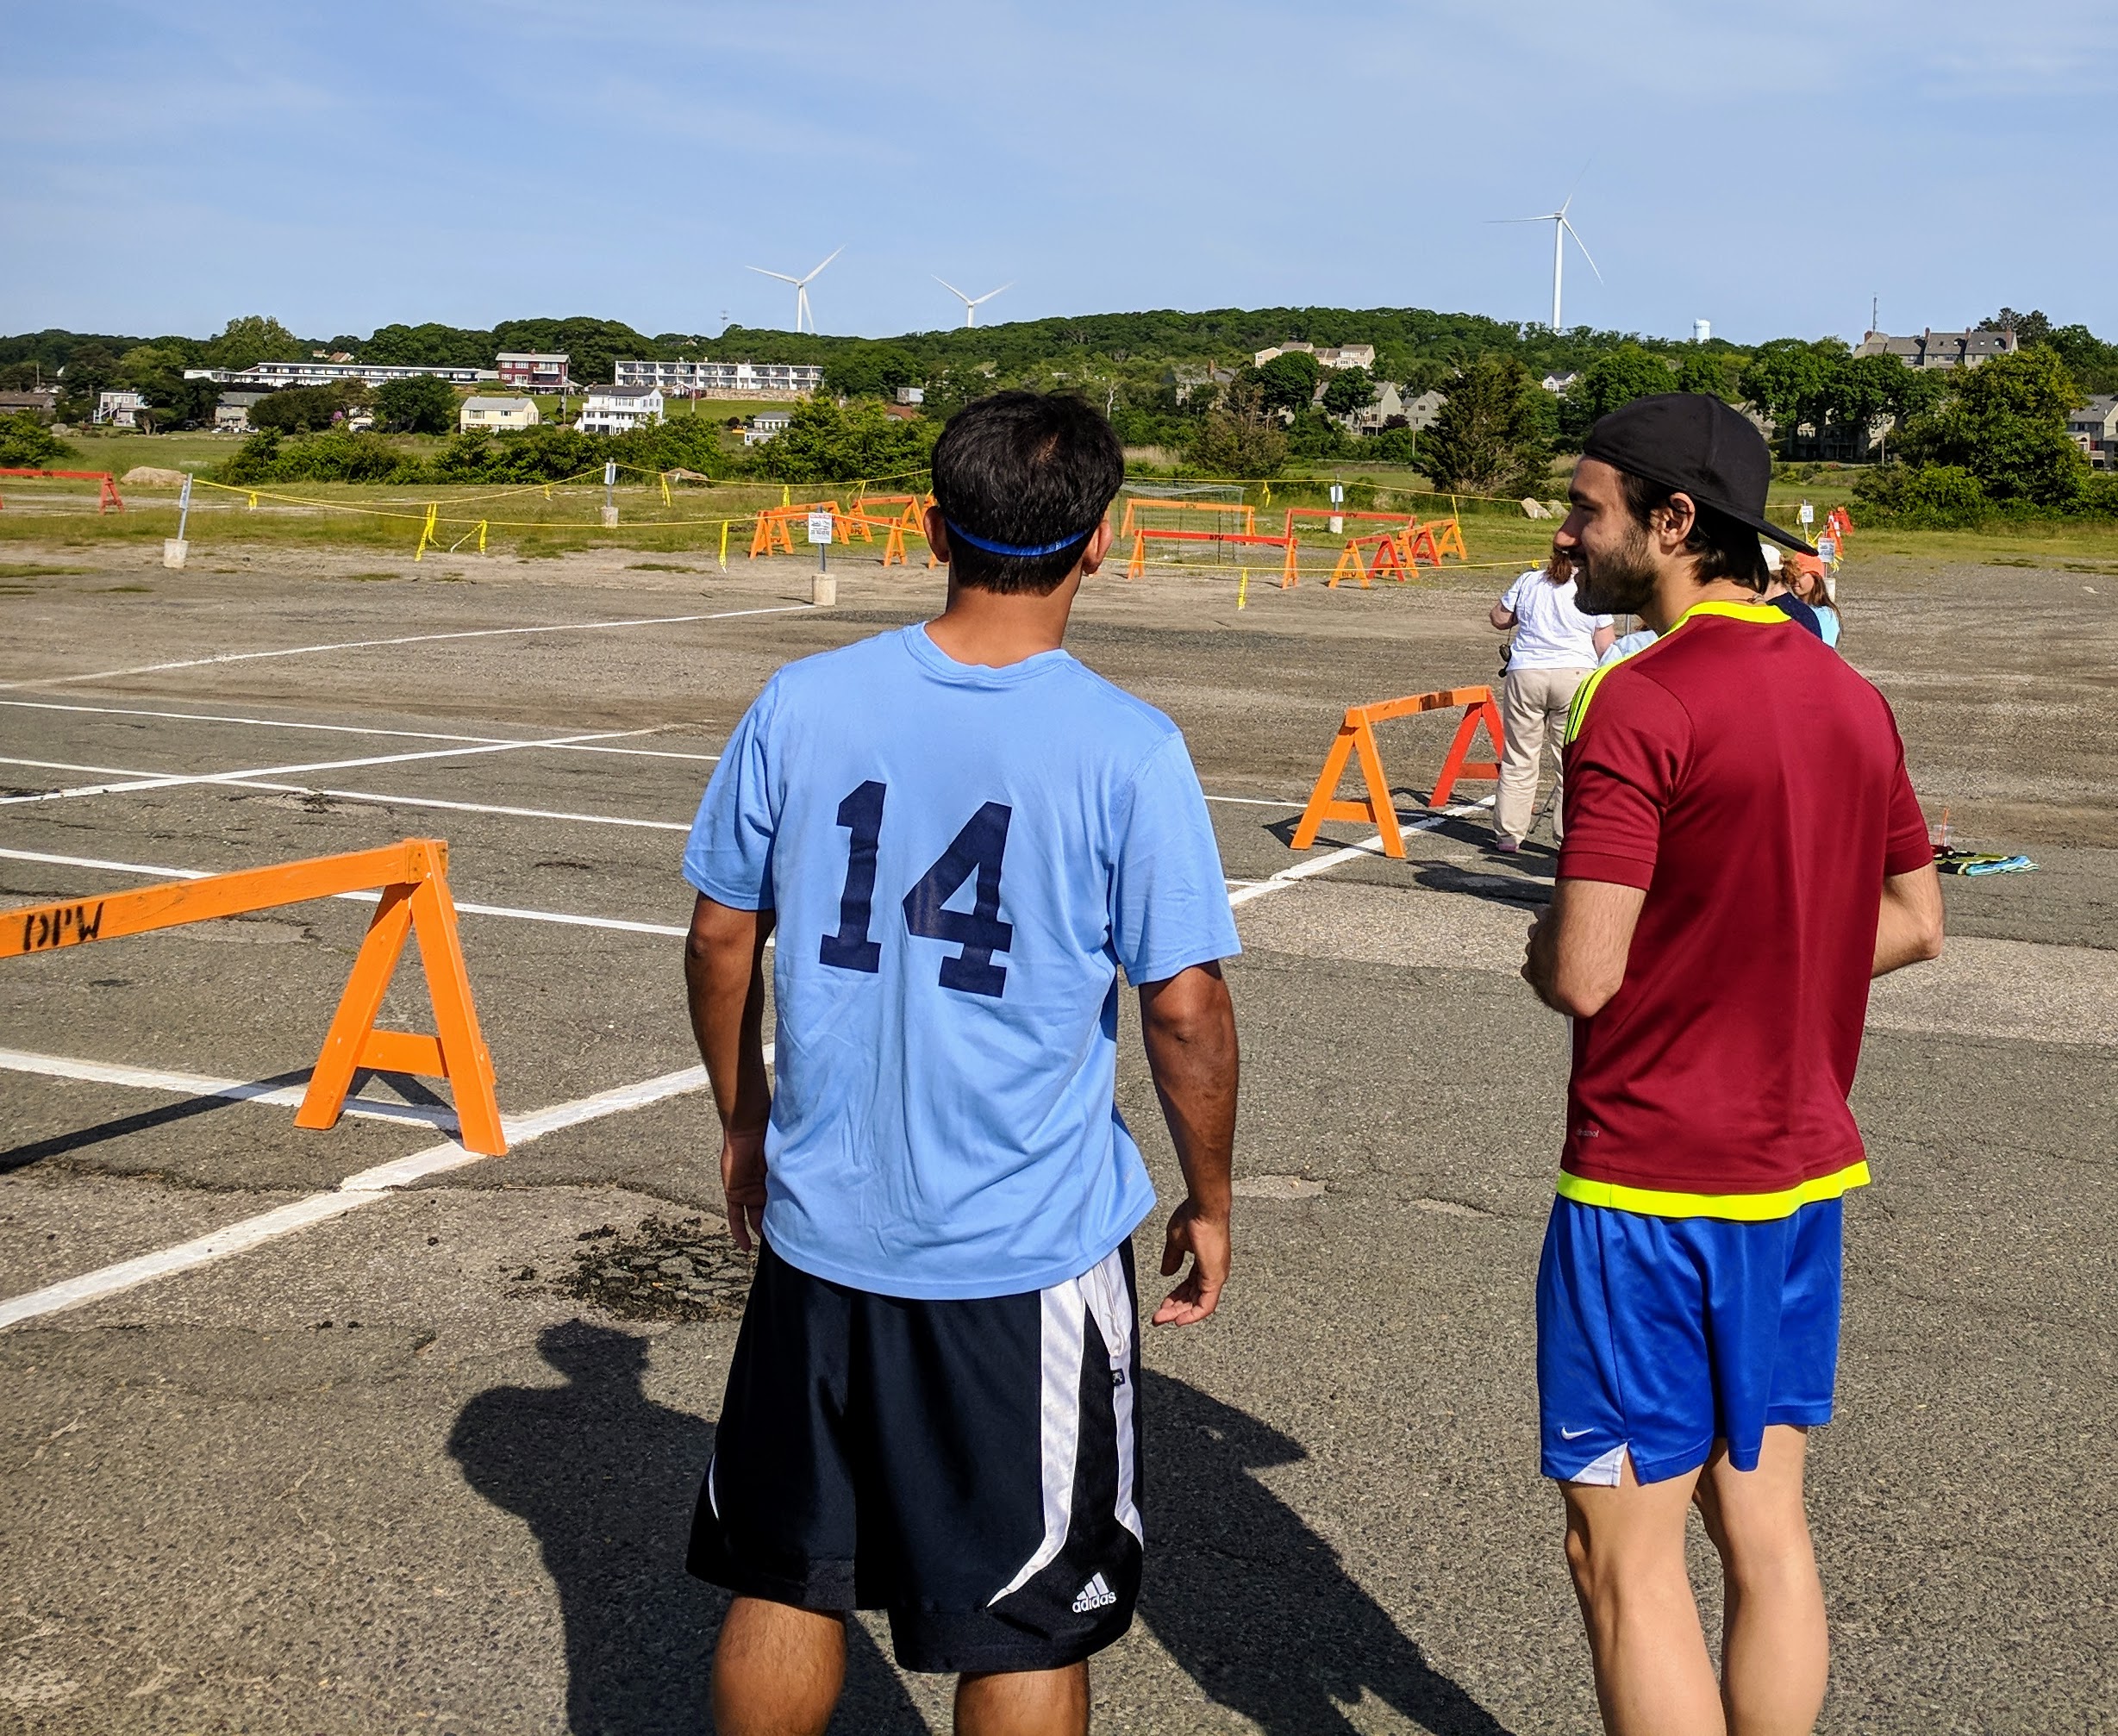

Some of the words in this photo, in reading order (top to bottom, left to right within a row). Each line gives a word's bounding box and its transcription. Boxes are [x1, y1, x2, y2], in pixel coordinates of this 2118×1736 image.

[820, 779, 1013, 998] 14
[23, 902, 103, 951] DPW
[1072, 1591, 1116, 1613] adidas
